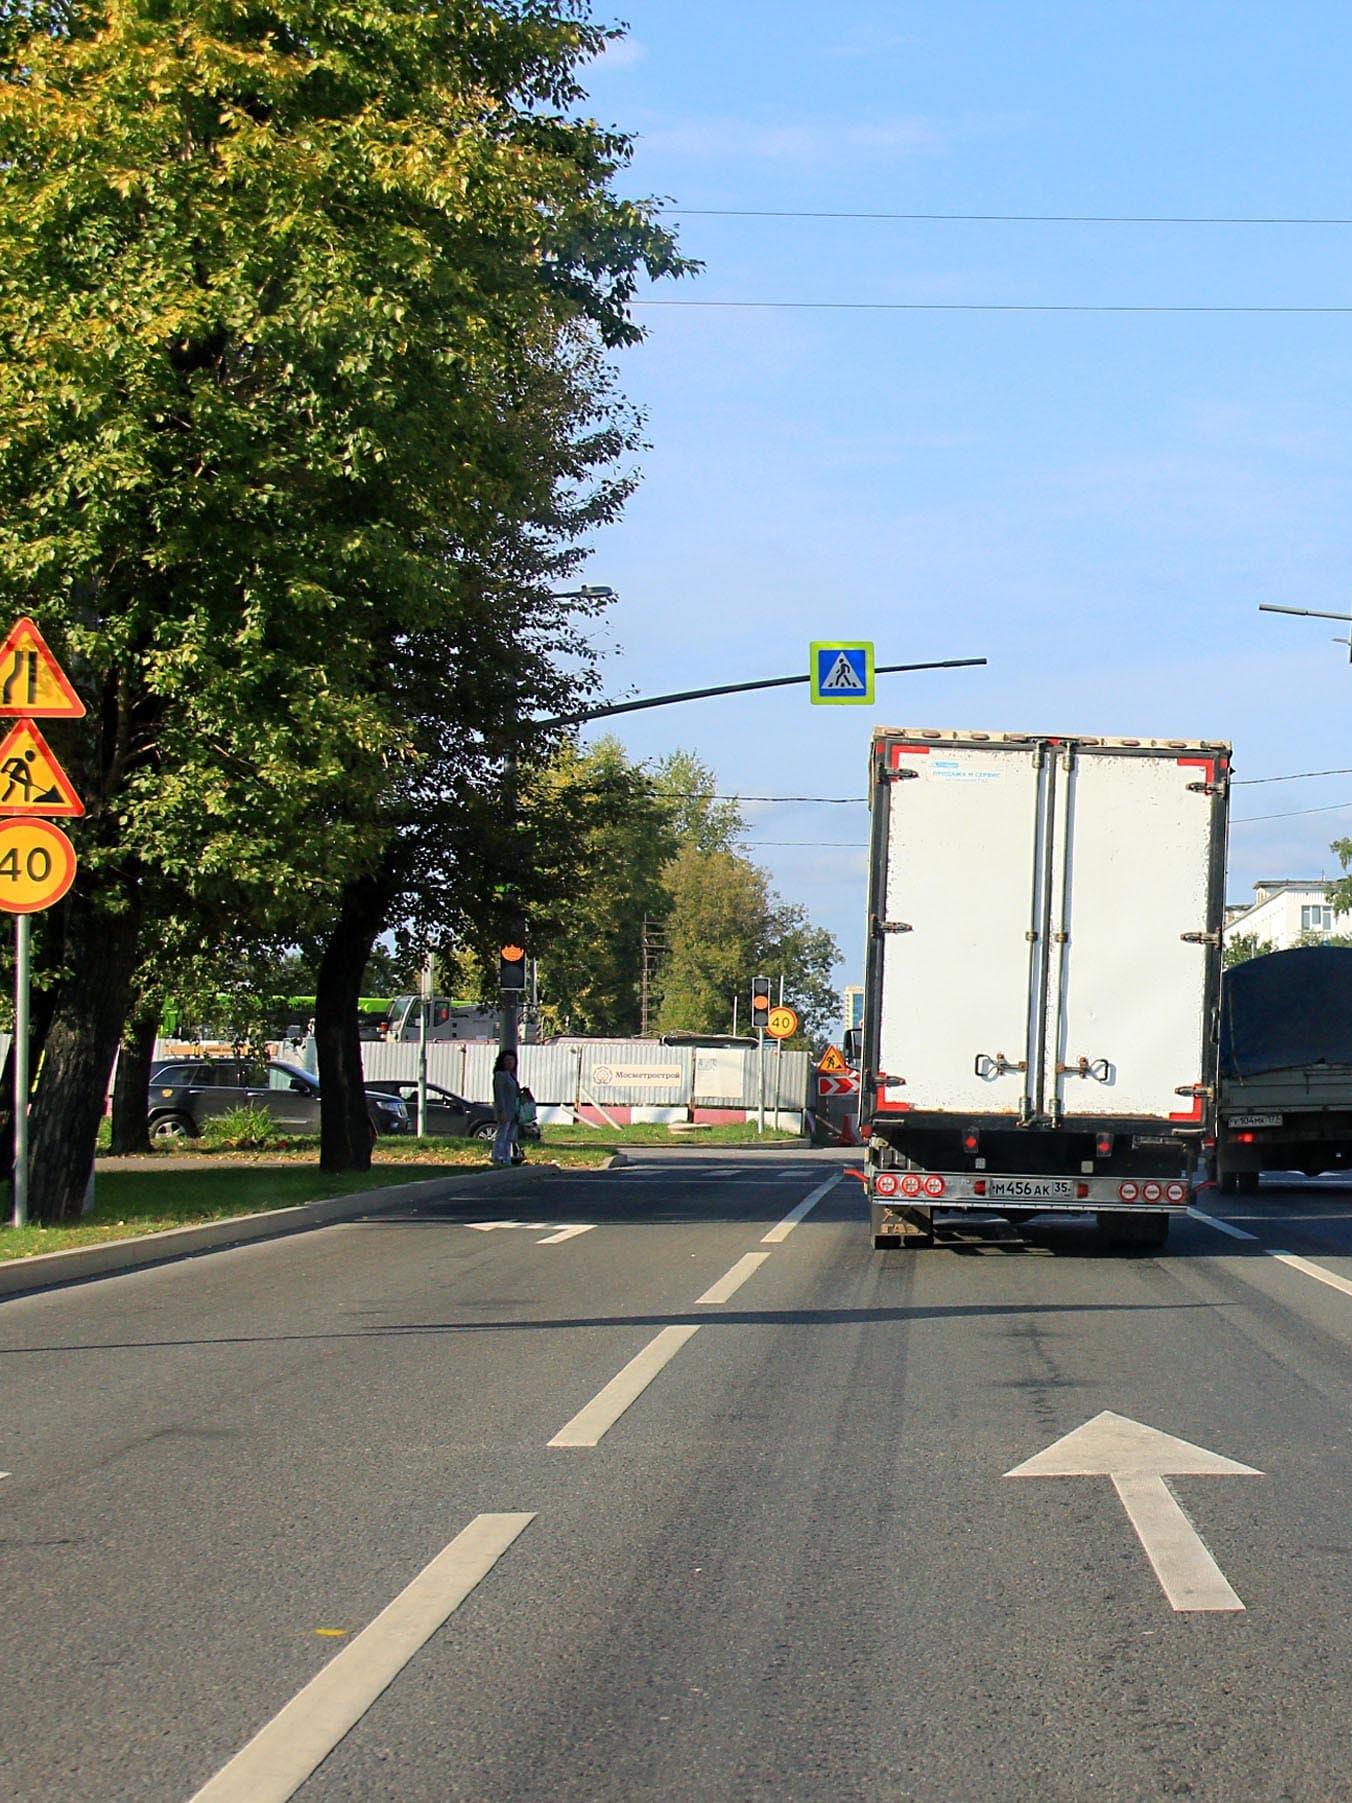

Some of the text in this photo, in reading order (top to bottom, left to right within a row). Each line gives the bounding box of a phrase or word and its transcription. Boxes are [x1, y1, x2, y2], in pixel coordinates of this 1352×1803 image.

[0, 847, 52, 882] 40
[772, 1016, 790, 1029] 40
[1054, 1182, 1068, 1193] 35
